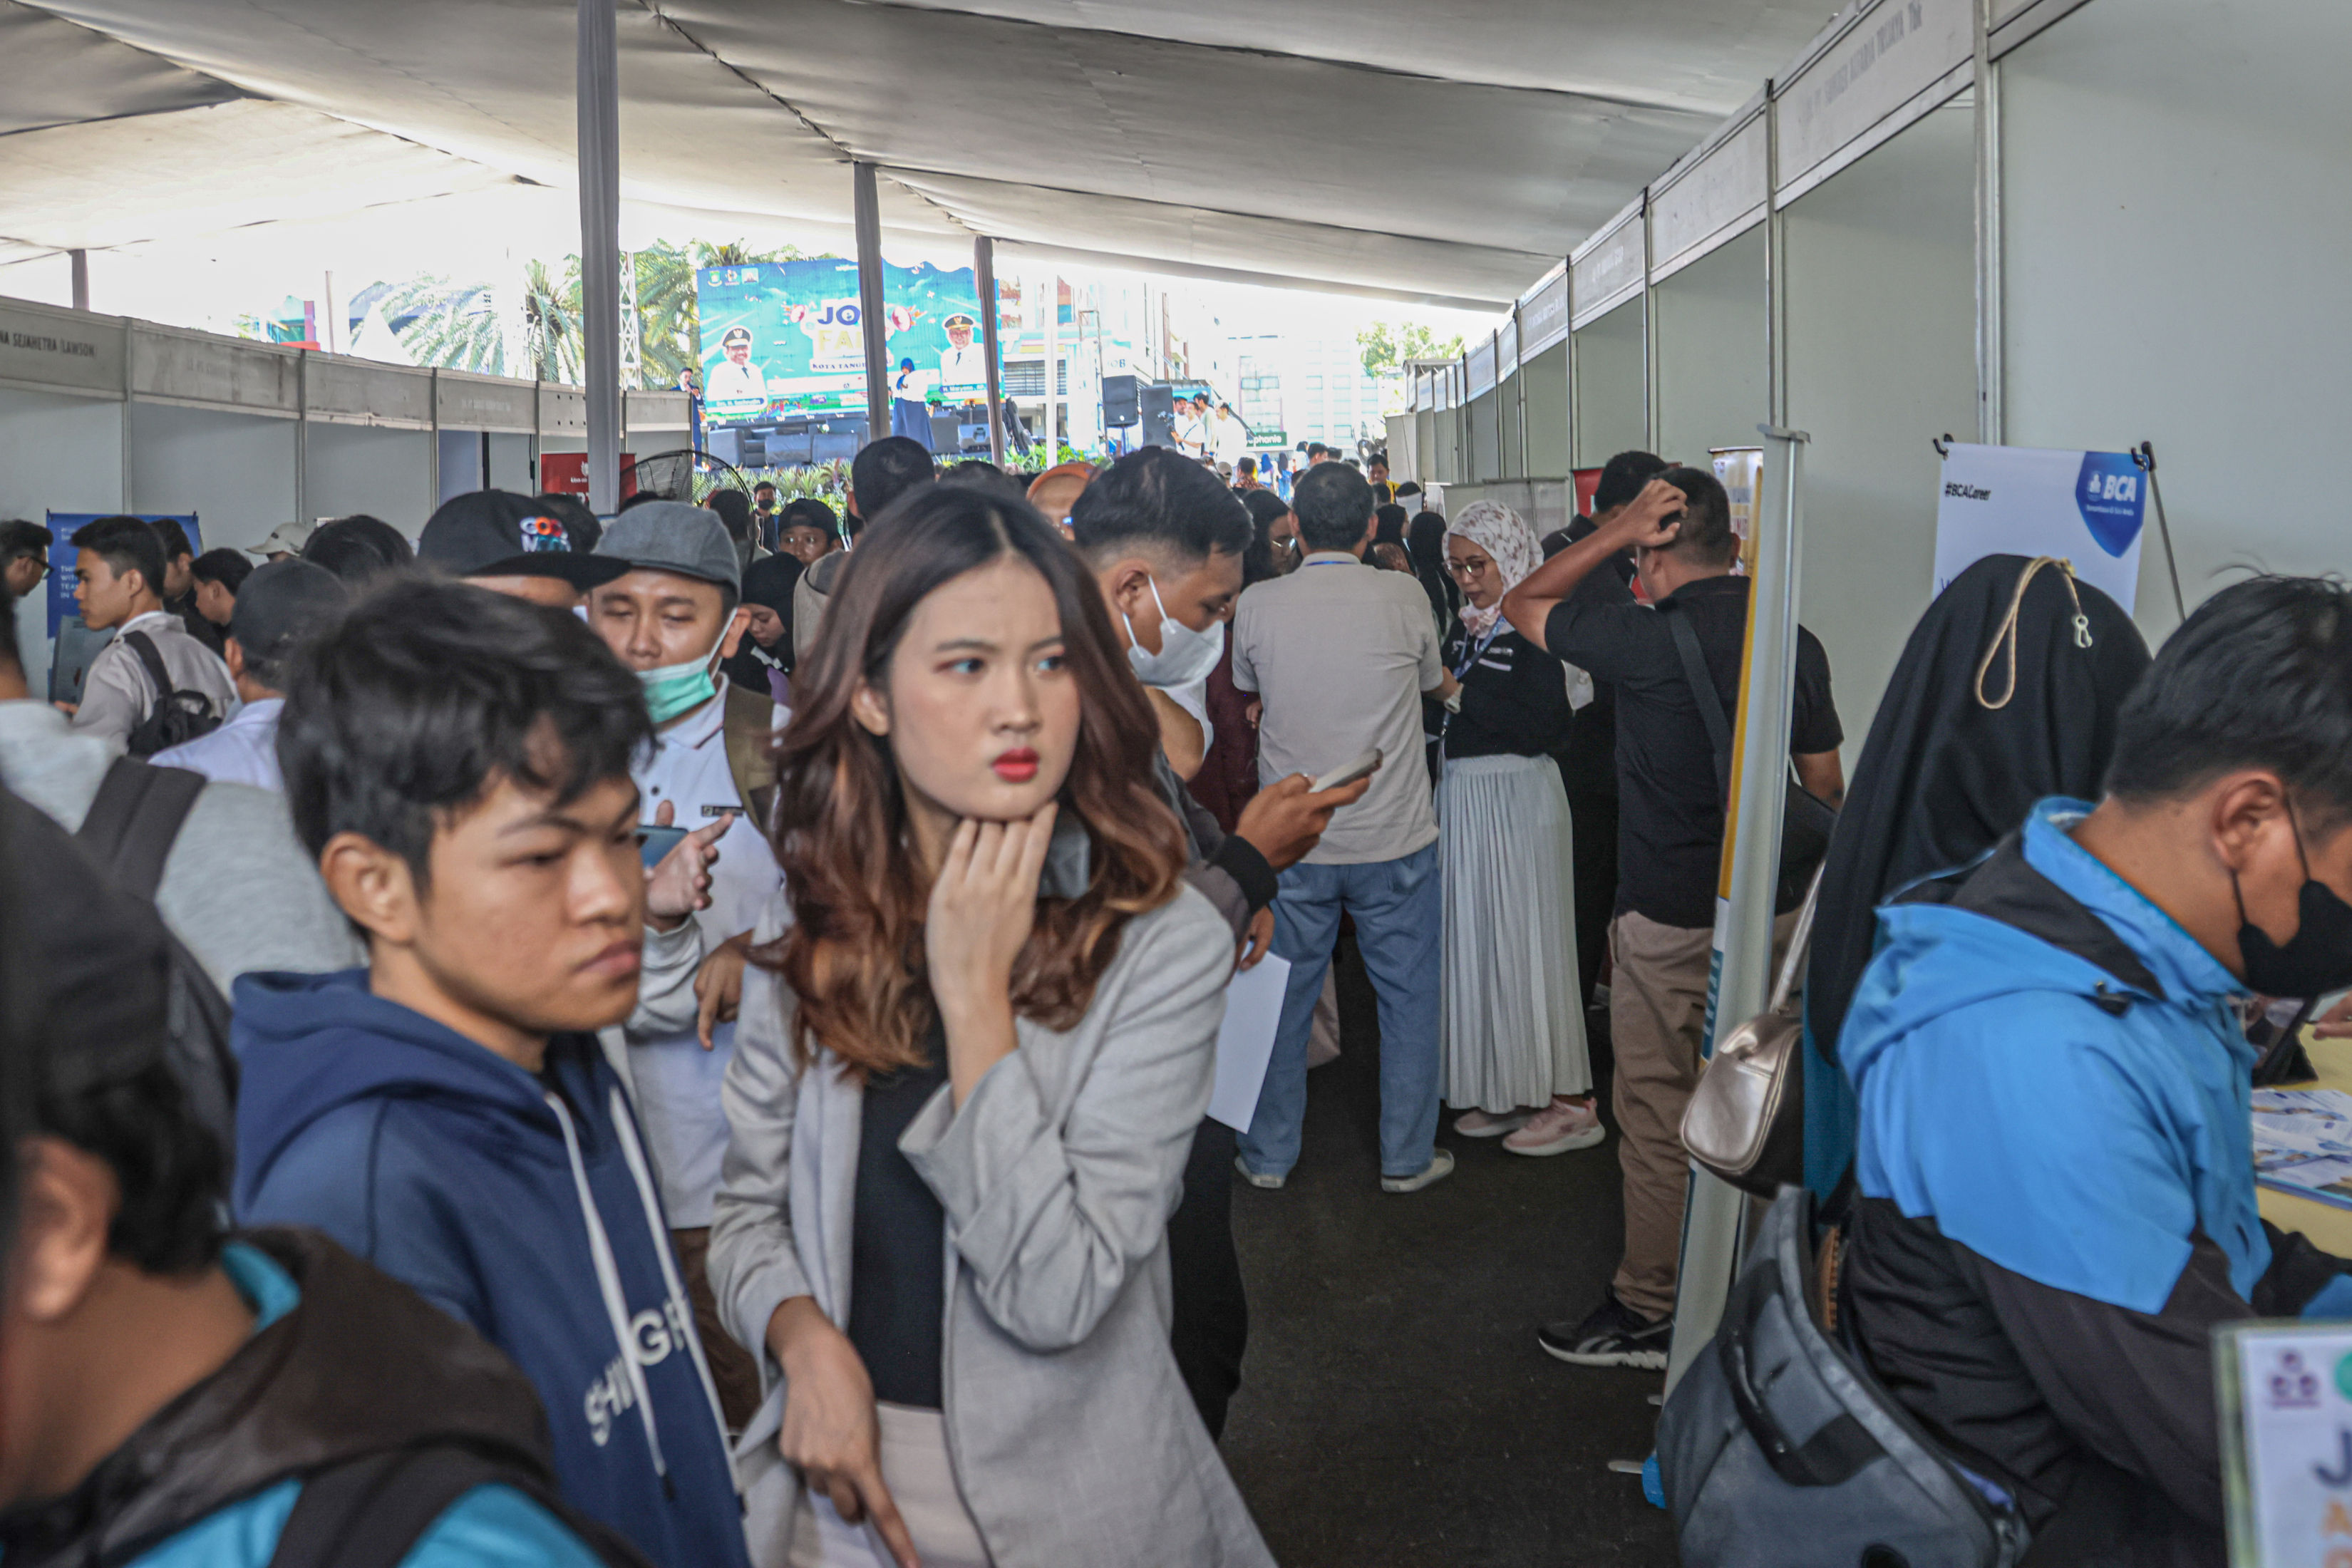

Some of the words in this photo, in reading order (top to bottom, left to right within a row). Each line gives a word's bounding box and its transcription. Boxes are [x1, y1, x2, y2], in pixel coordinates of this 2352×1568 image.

[817, 304, 861, 326] JO
[818, 329, 863, 352] FAI
[1944, 481, 1991, 502] #BCACareer
[2103, 475, 2137, 502] BCA
